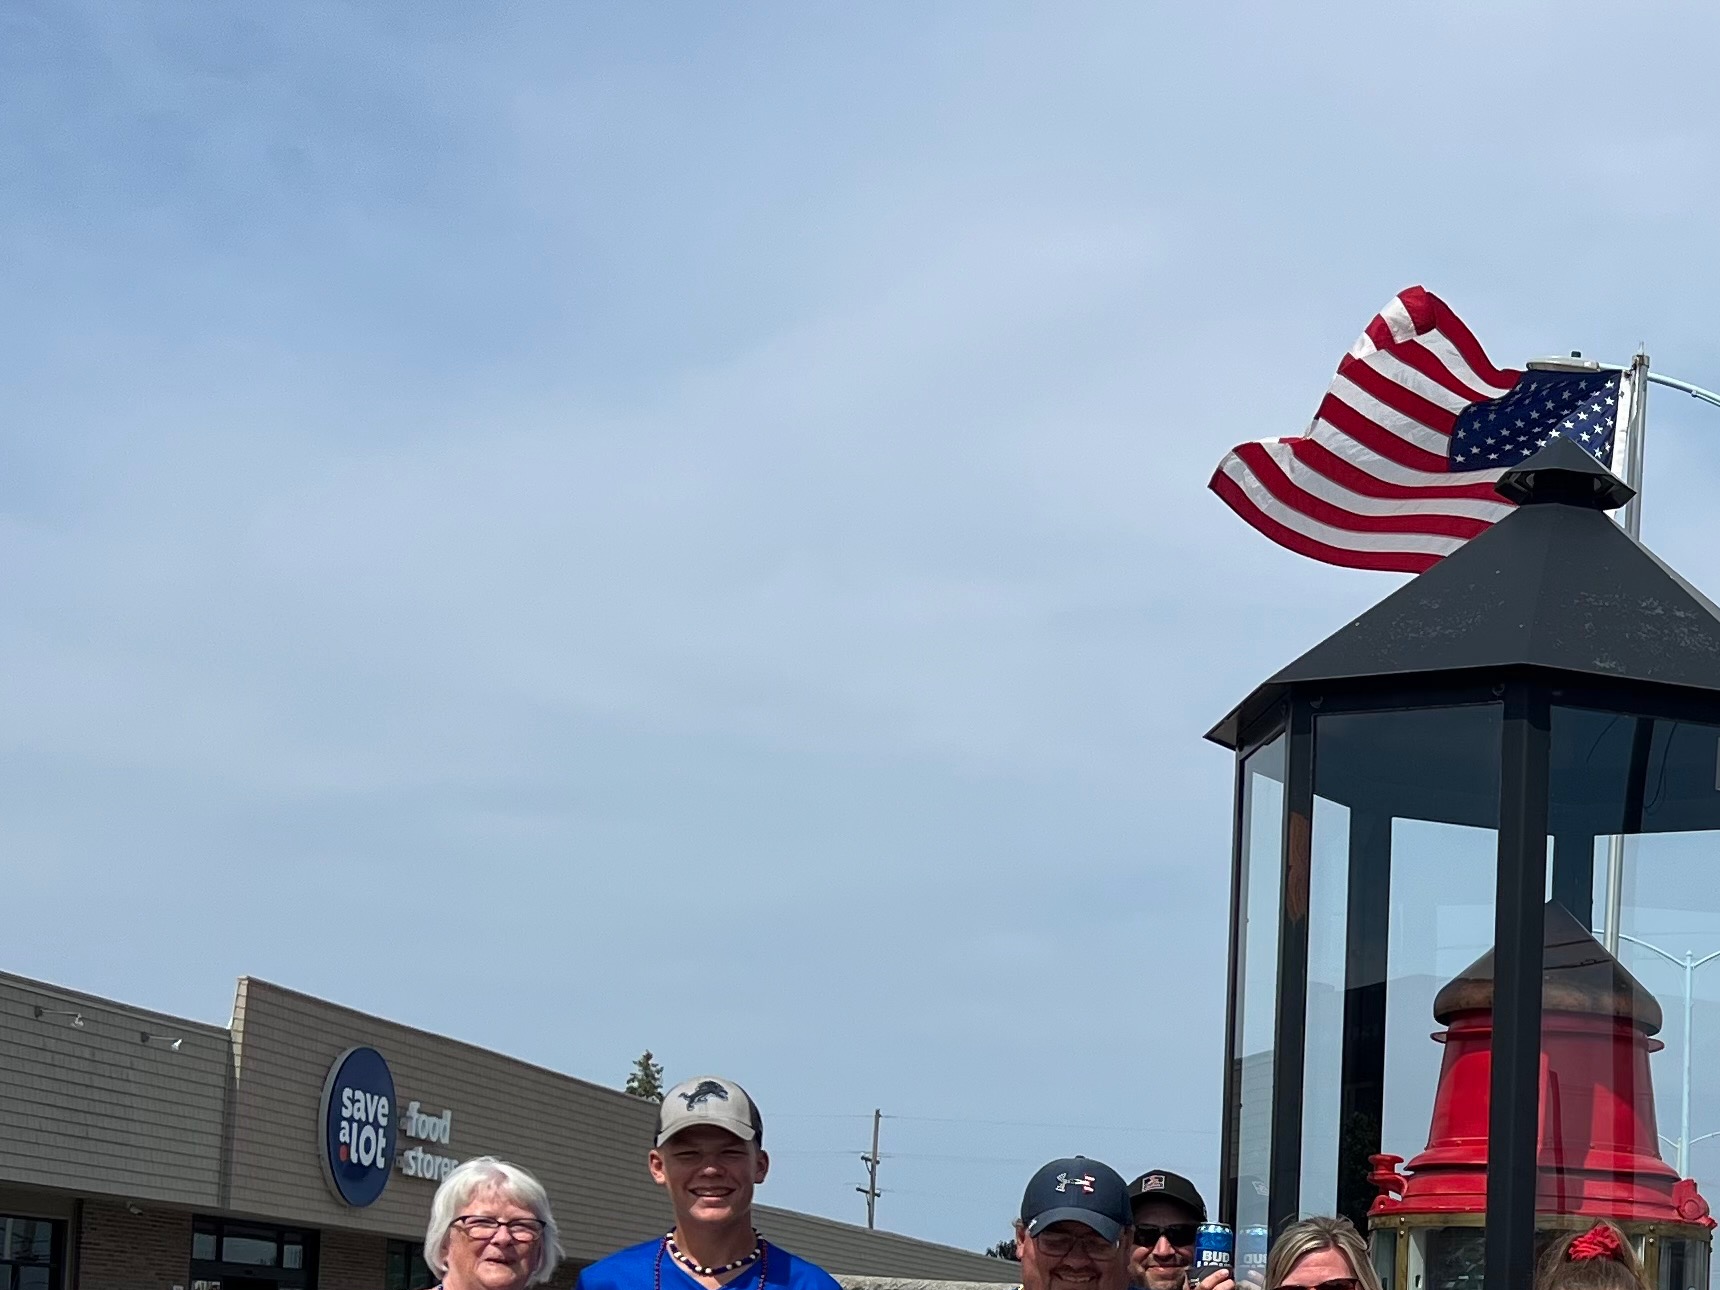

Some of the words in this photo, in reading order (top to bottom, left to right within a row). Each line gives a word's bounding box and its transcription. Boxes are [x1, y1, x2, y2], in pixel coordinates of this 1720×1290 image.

[342, 1087, 389, 1127] save
[406, 1101, 452, 1144] food
[339, 1120, 350, 1143] a
[1202, 1250, 1230, 1263] BUD
